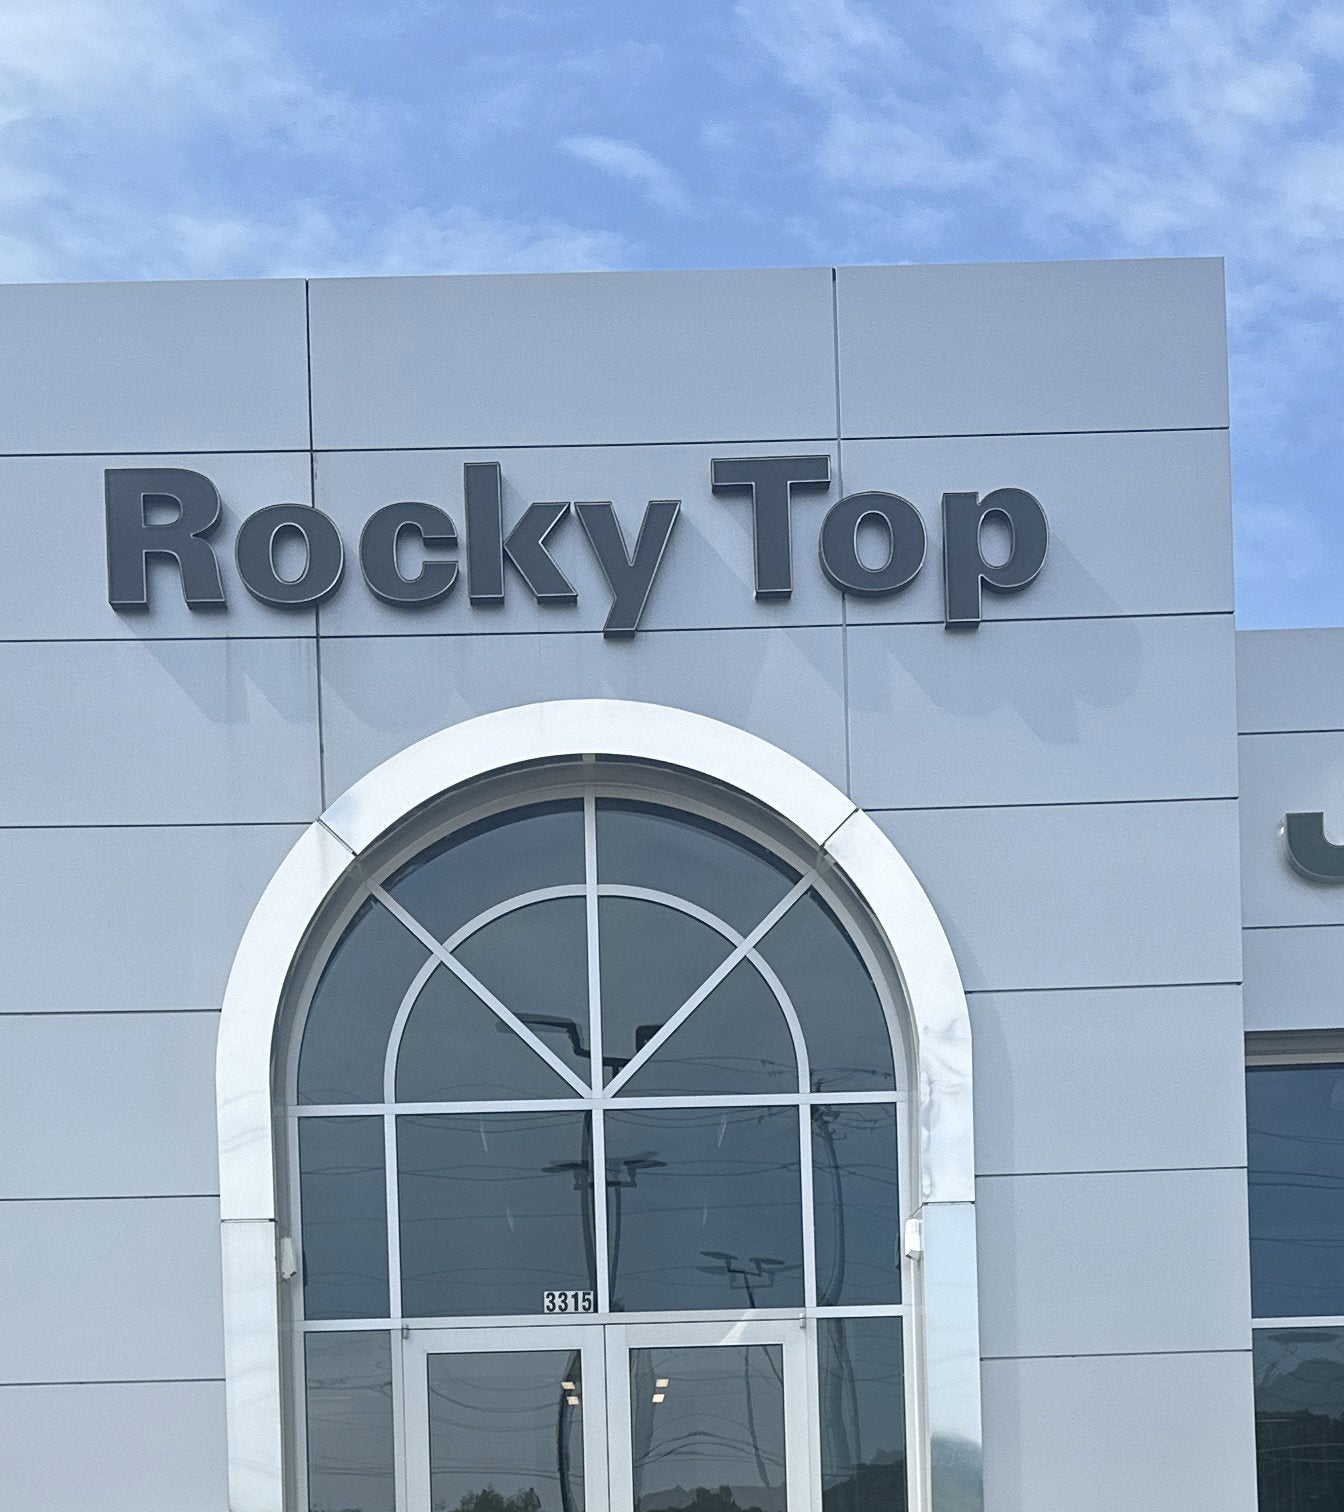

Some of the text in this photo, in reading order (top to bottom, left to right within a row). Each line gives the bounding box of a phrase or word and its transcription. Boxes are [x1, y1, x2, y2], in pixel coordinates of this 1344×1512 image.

[104, 454, 1050, 639] Rocky Top
[545, 1291, 592, 1312] 3315
